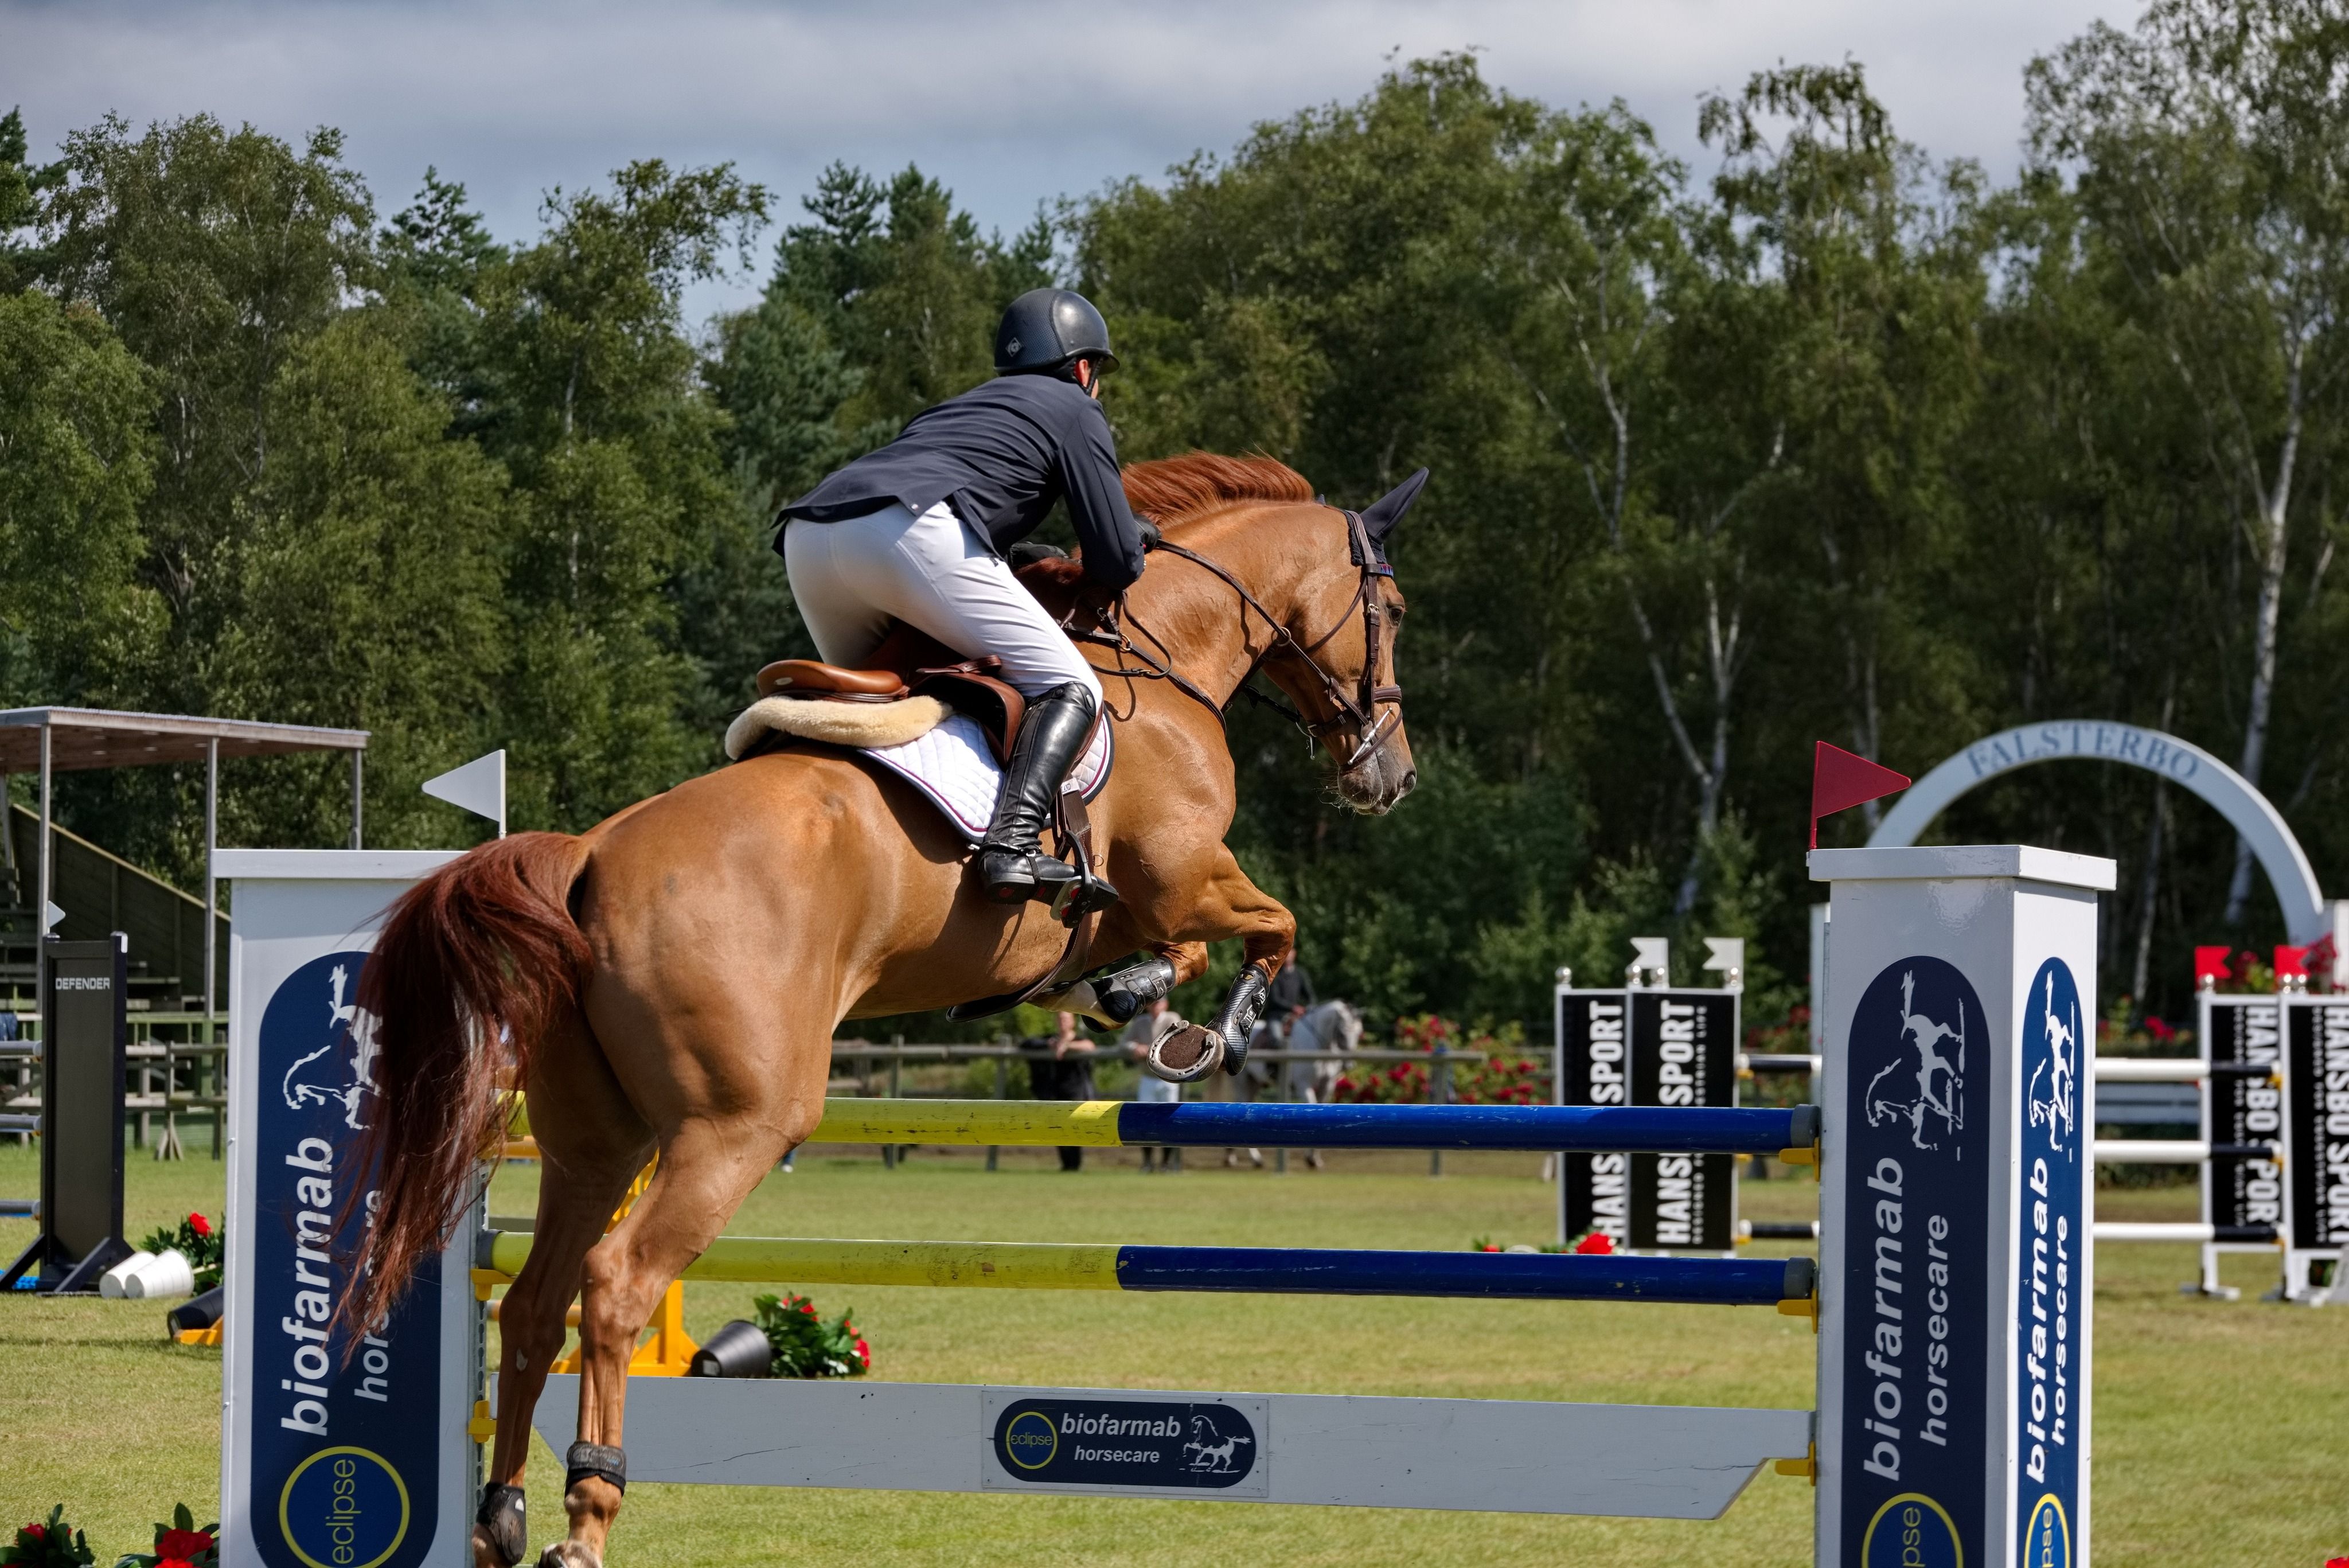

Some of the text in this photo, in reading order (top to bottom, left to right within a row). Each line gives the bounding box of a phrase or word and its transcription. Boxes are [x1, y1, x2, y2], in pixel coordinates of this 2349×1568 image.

[1967, 720, 2200, 781] FALSTERBO
[55, 977, 110, 990] DEFENDER
[2246, 1006, 2280, 1132] HANBO
[1589, 1000, 1625, 1238] HANS SPORT
[1656, 1000, 1695, 1244] HANS SPORT
[280, 1137, 333, 1436] biofarmab
[1863, 1157, 1903, 1481] biofarmab
[1919, 1215, 1949, 1446] horsecare
[2026, 1157, 2049, 1484] biofarmab
[2051, 1215, 2067, 1445] horsecare
[325, 1458, 362, 1565] eclipse
[1010, 1432, 1053, 1448] eclipse
[1061, 1413, 1181, 1437] biofarmab
[1074, 1445, 1160, 1463] horsecare
